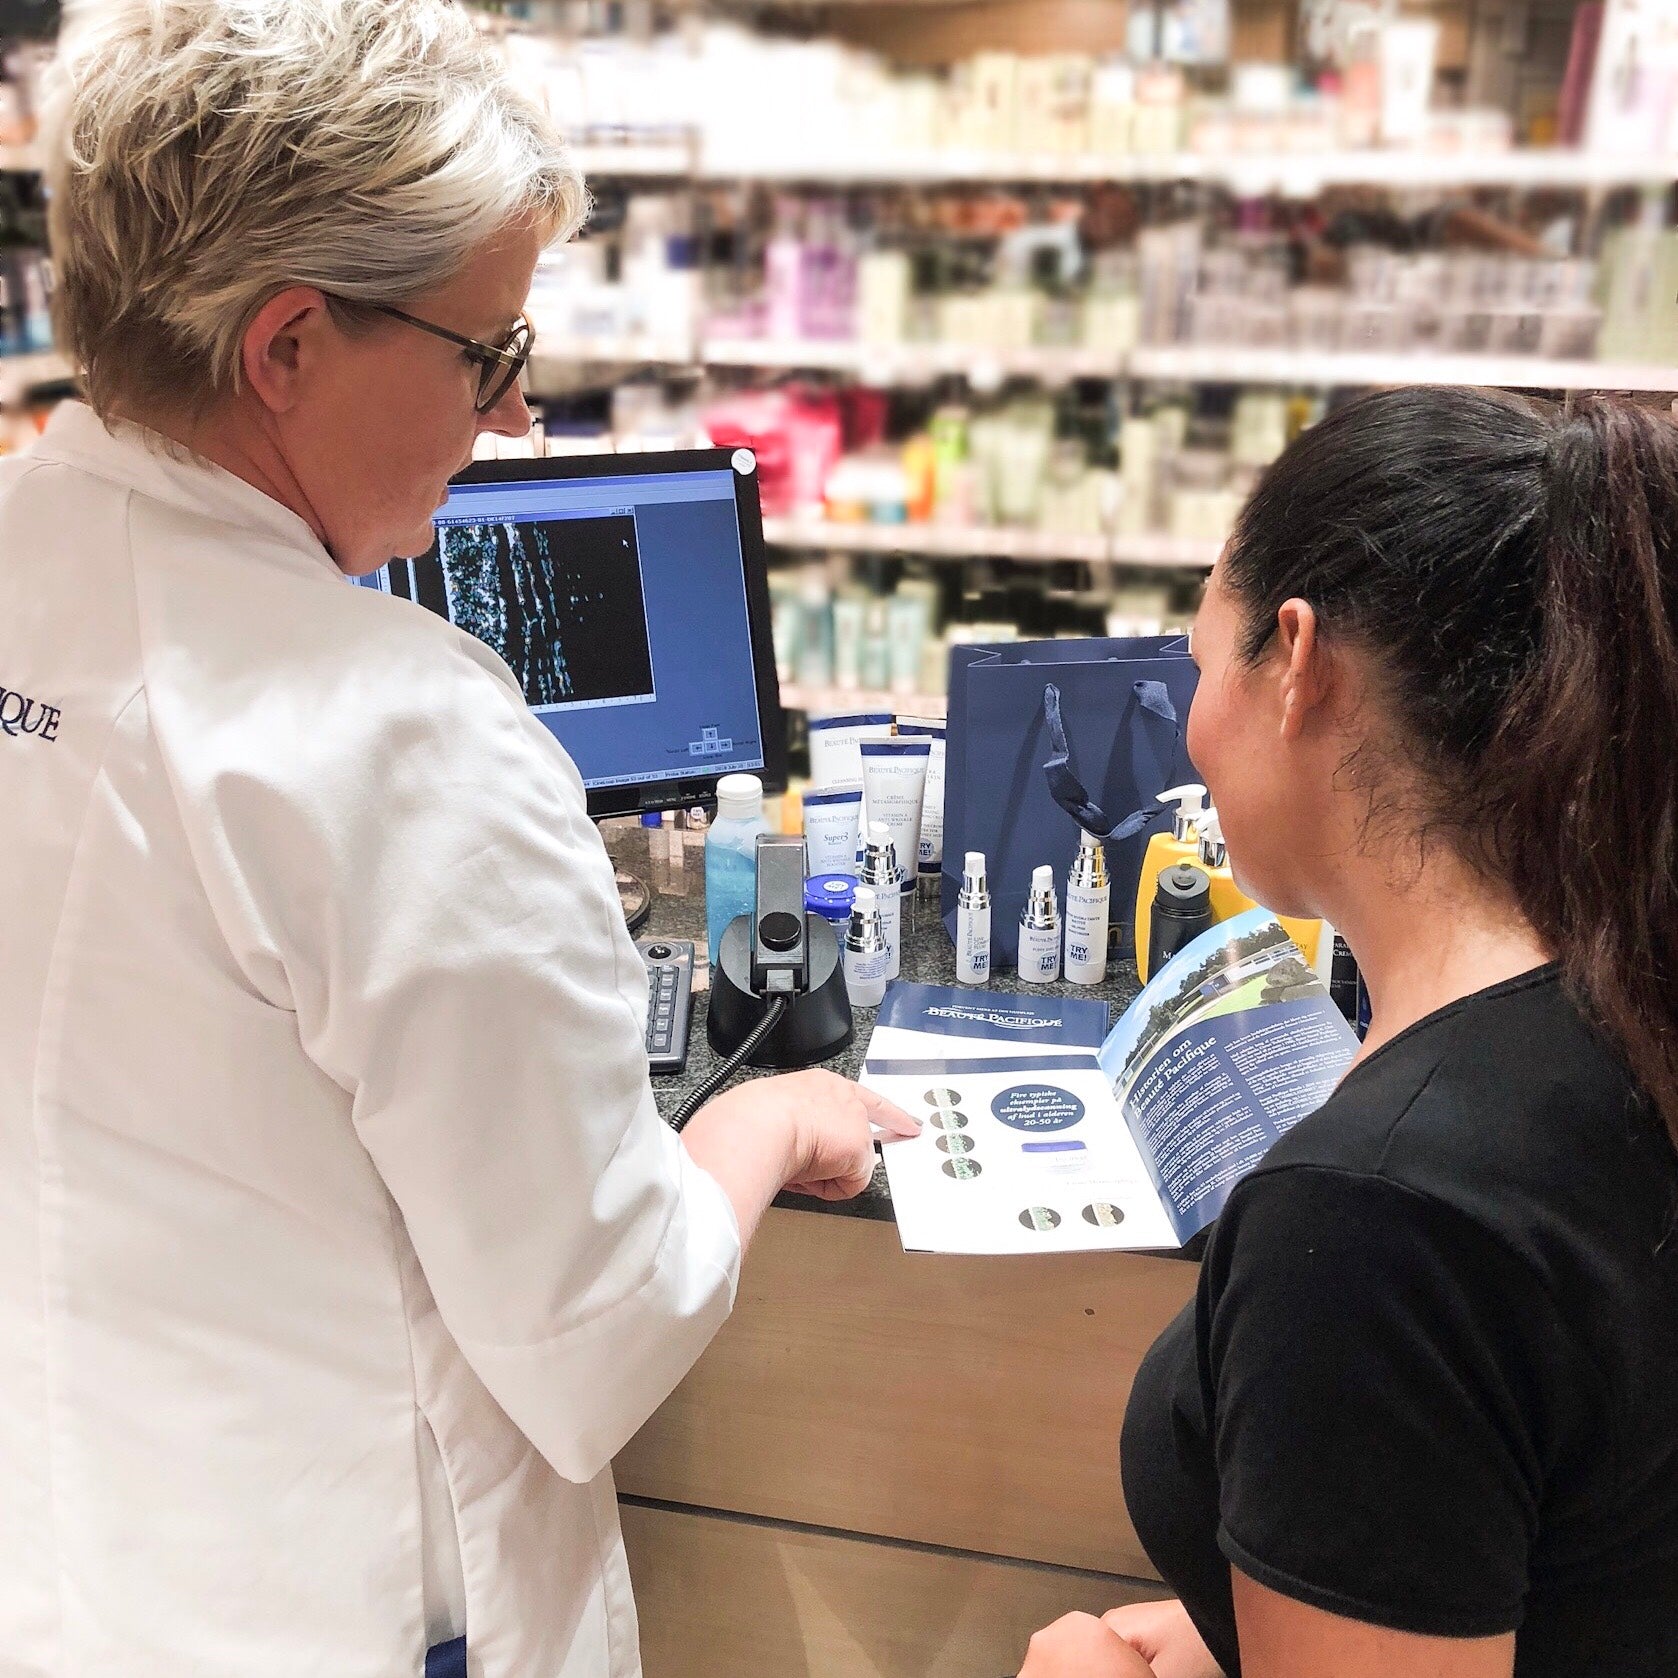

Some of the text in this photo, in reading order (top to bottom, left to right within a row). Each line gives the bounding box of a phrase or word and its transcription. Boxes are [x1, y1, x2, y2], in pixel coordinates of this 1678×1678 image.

[1070, 944, 1088, 954] TRY
[973, 954, 989, 963] TRY
[1040, 954, 1058, 964] TRY
[1070, 952, 1087, 962] ME!
[1129, 1039, 1193, 1109] Historien om
[1133, 1078, 1165, 1119] Beauté
[1163, 1036, 1217, 1081] Pacifique
[1023, 1118, 1051, 1127] 20-50
